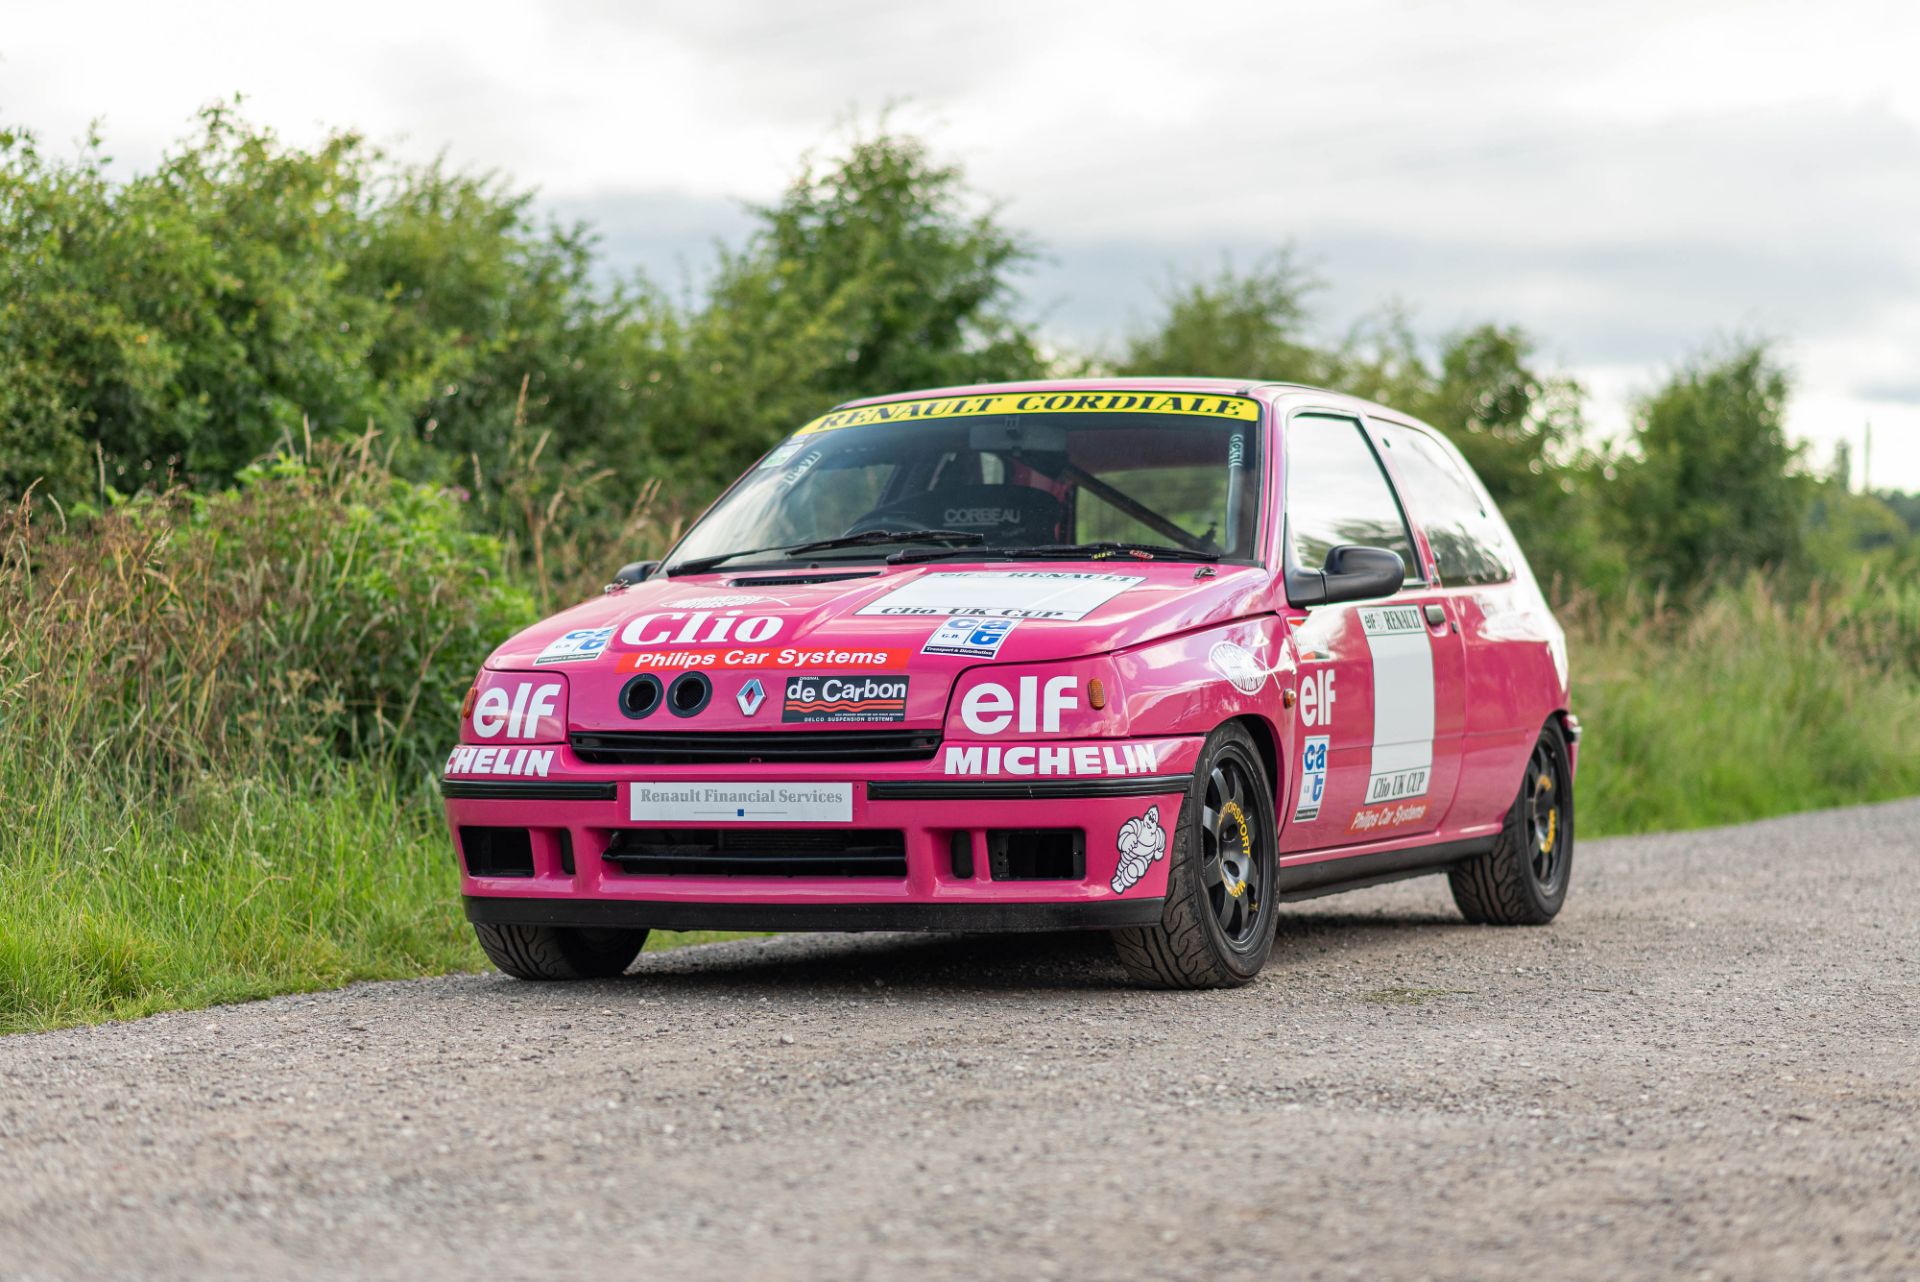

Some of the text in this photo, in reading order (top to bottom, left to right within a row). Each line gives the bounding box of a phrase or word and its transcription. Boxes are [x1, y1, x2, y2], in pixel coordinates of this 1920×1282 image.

[818, 394, 1245, 430] RENAULT CORDIALE
[943, 508, 1021, 524] CORBEAU
[1007, 572, 1136, 582] RENAULT
[948, 608, 994, 616] UK
[1001, 608, 1064, 618] CUP
[1383, 610, 1421, 630] RENAULT
[621, 609, 784, 646] Clio
[634, 648, 888, 669] Philips Car Systems
[787, 679, 906, 702] de Carbon
[1300, 668, 1335, 727] elf
[473, 682, 561, 738] elf
[961, 676, 1078, 735] elf
[944, 744, 1158, 775] MICHELIN
[640, 789, 843, 803] Renault Financial Services
[1373, 772, 1425, 799] Clio UK CUP
[1350, 805, 1426, 831] Philips Car Systems
